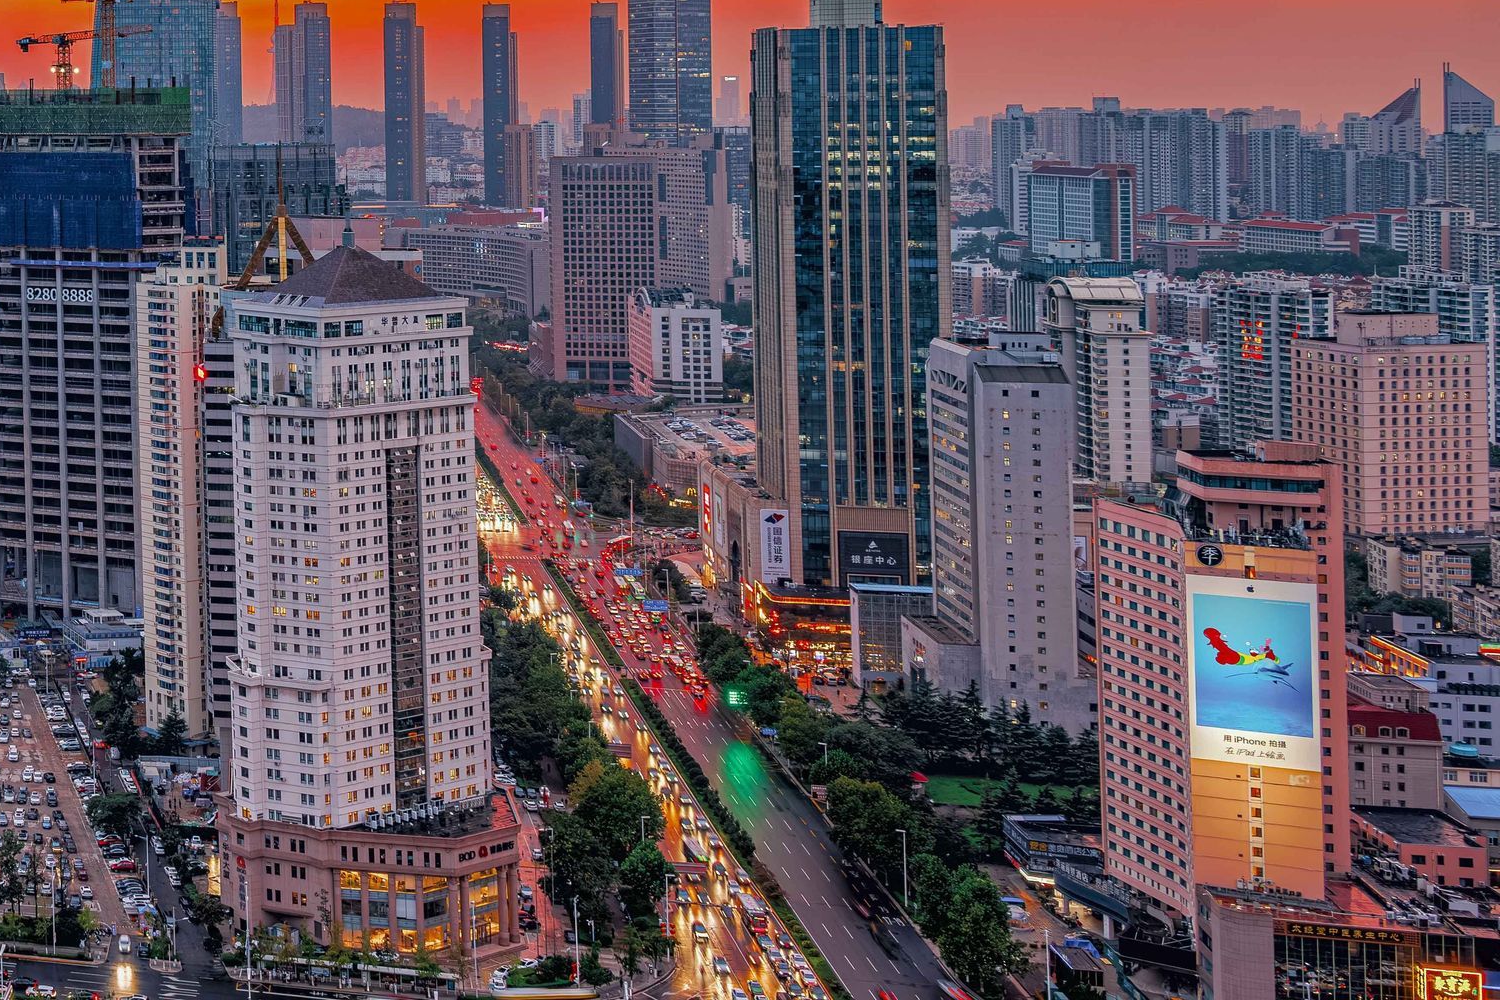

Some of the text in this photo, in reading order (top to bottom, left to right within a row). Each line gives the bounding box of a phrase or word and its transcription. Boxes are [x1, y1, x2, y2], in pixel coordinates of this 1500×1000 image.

[26, 287, 93, 303] 8280 8888
[851, 555, 897, 566] 银座中心
[1223, 735, 1232, 743] 用
[1234, 735, 1267, 747] iPhone
[1225, 747, 1234, 755] 在
[1236, 748, 1256, 757] iPad
